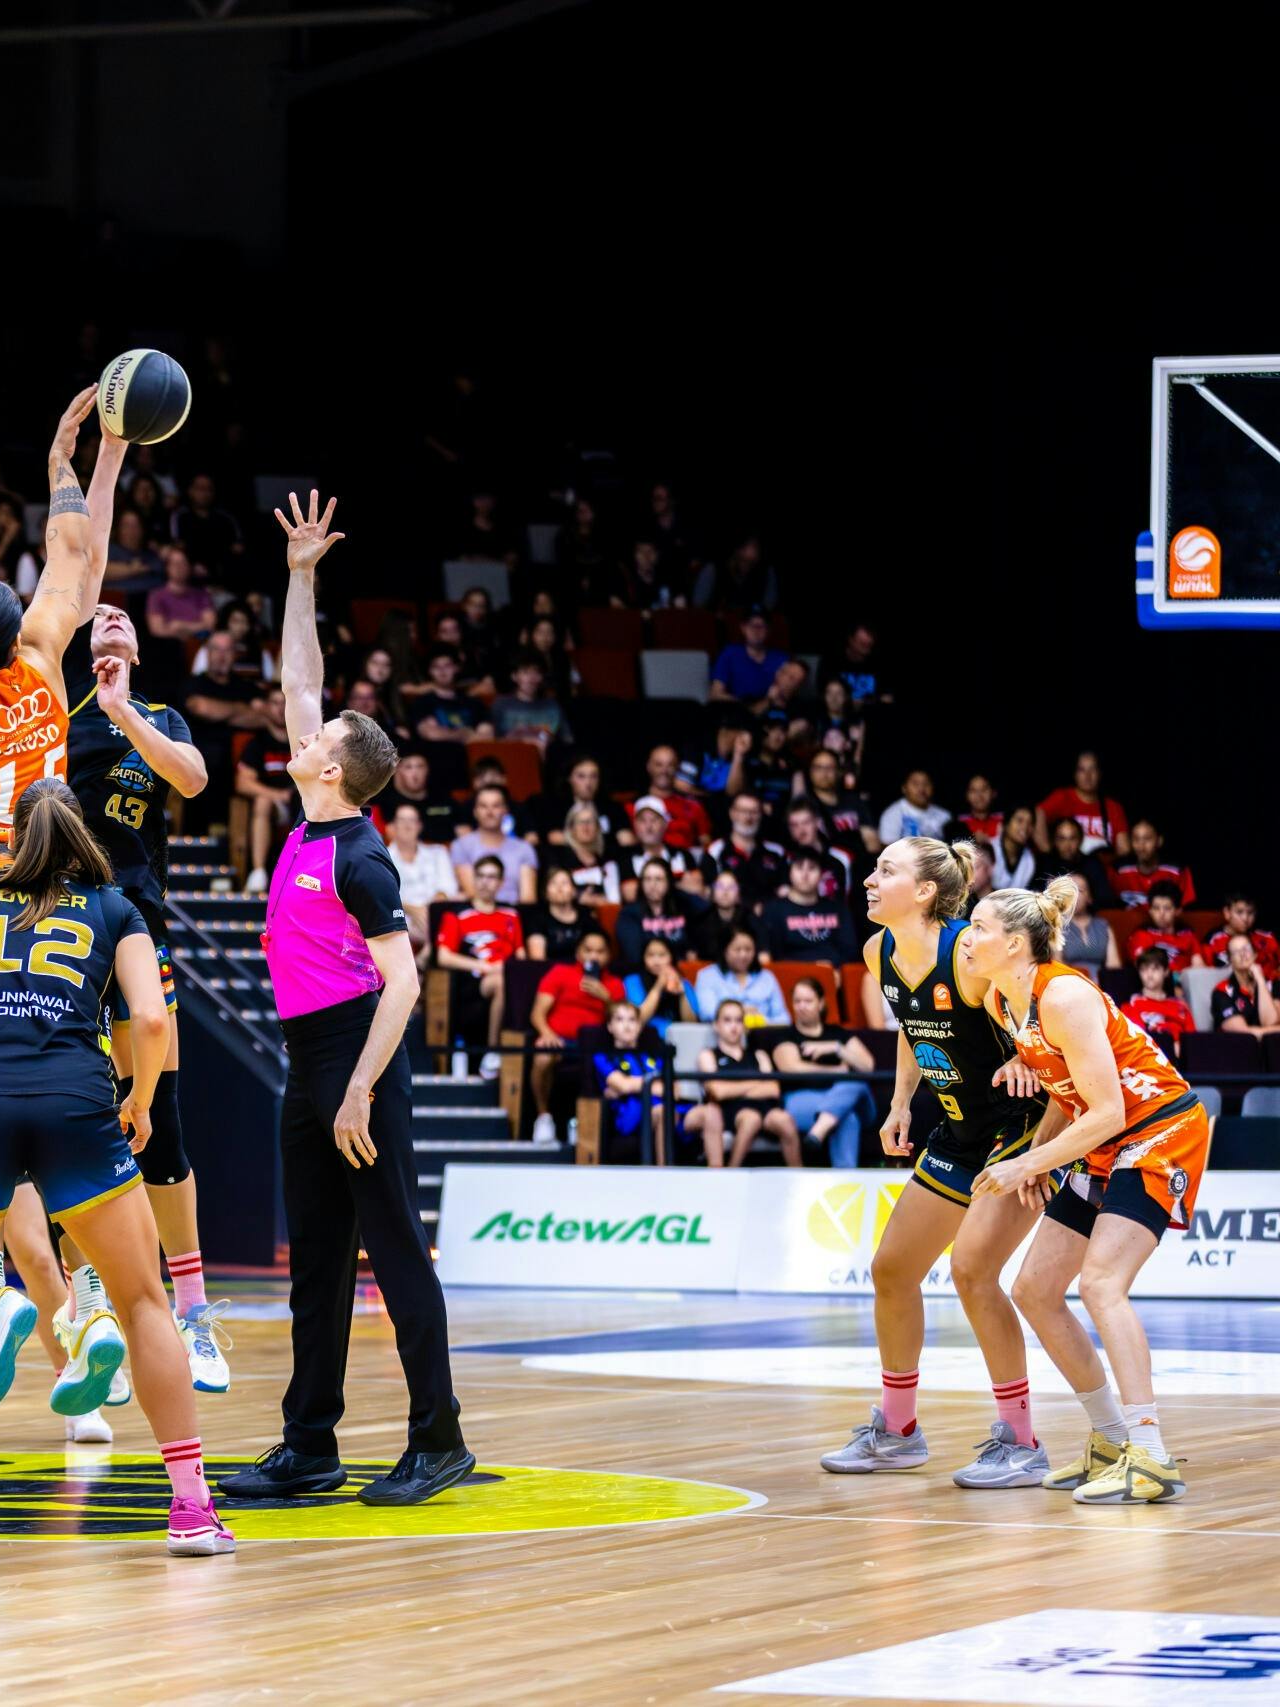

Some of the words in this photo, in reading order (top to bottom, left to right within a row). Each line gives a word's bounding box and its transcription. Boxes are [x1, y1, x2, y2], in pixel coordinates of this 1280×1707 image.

[105, 356, 133, 415] SPALDING
[109, 767, 154, 791] CAPITALS
[104, 793, 148, 830] 43
[905, 1018, 939, 1029] UNIVERSITY
[940, 1020, 952, 1029] OF
[907, 1026, 955, 1040] CANBERRA
[937, 1093, 964, 1121] 9
[471, 1210, 711, 1245] ActewAGL
[1186, 1249, 1237, 1267] ACT
